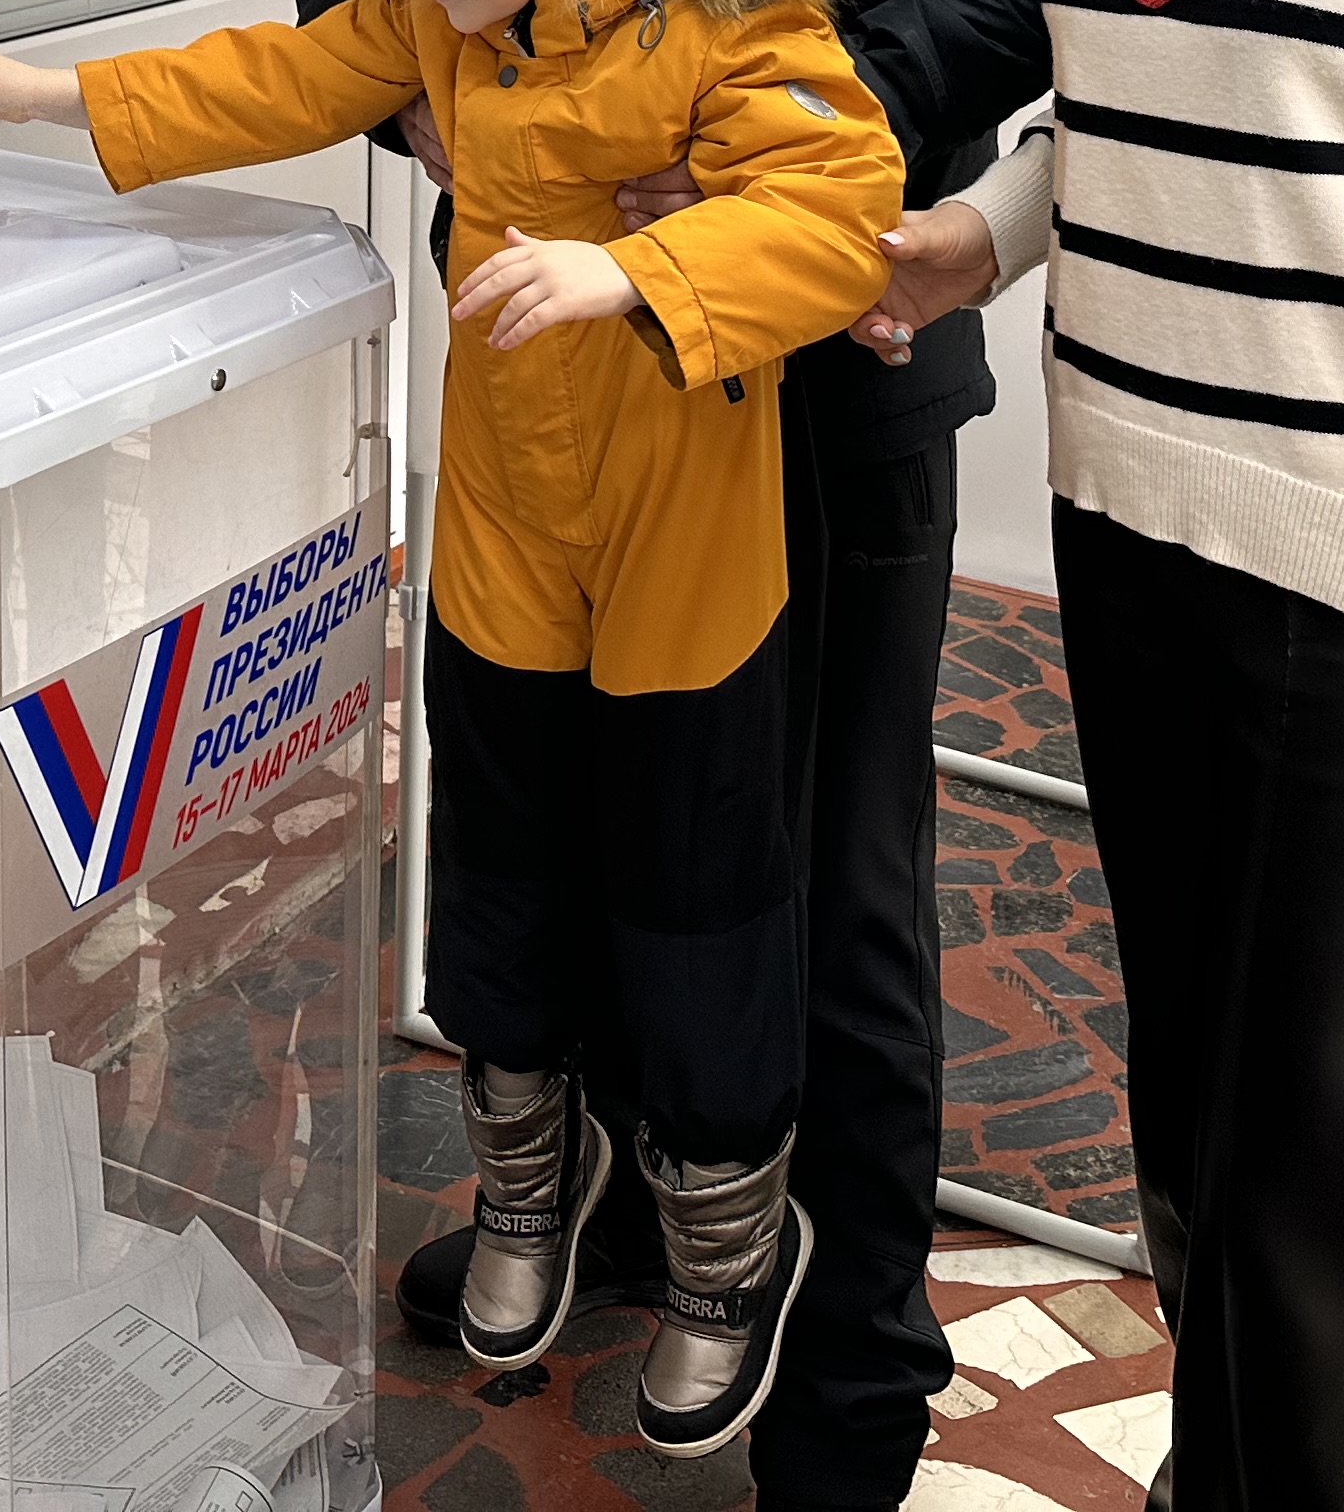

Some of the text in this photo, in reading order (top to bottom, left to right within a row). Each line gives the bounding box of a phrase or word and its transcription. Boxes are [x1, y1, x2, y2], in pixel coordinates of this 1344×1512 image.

[203, 553, 387, 711] ПРЕЗИДЕНТА
[220, 512, 361, 637] ВЫБОРЫ
[185, 657, 322, 785] РОССИИ
[245, 725, 321, 803] МАРТА
[324, 676, 370, 745] 2024
[480, 1204, 561, 1233] FROSTERRA
[666, 1280, 726, 1320] STERRA
